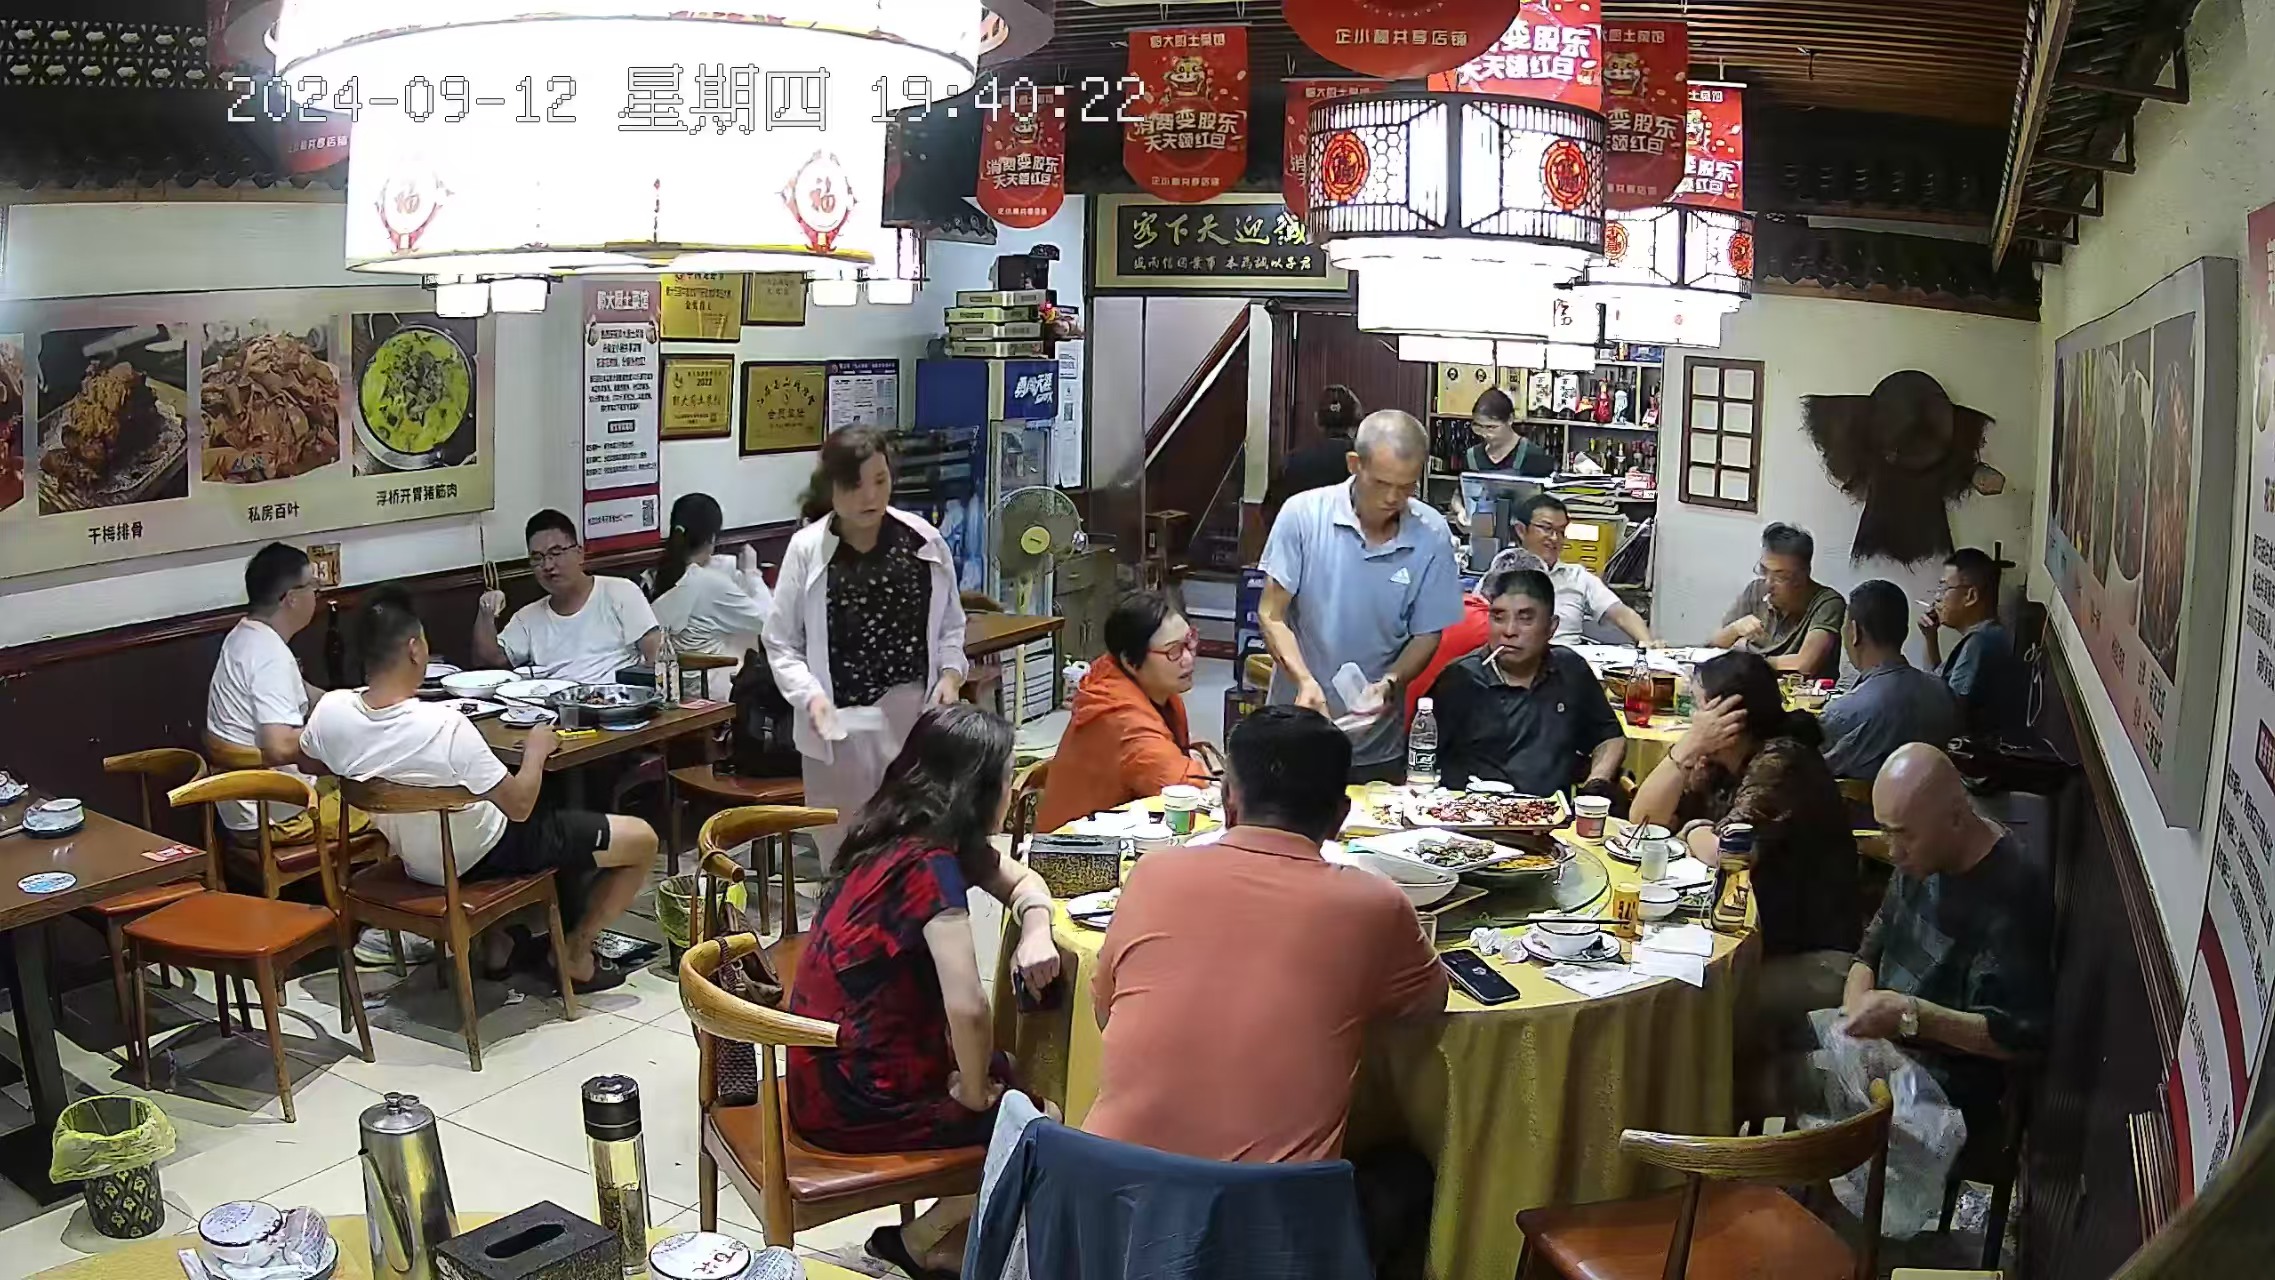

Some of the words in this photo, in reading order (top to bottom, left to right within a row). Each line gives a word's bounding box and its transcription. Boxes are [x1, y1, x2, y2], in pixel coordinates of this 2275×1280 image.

[1134, 109, 1239, 135] 消费变股东
[1144, 133, 1226, 152] 天天领红包
[986, 153, 1059, 175] 消费变股东
[993, 173, 1052, 190] 天天领红包
[248, 501, 300, 523] 私房百叶
